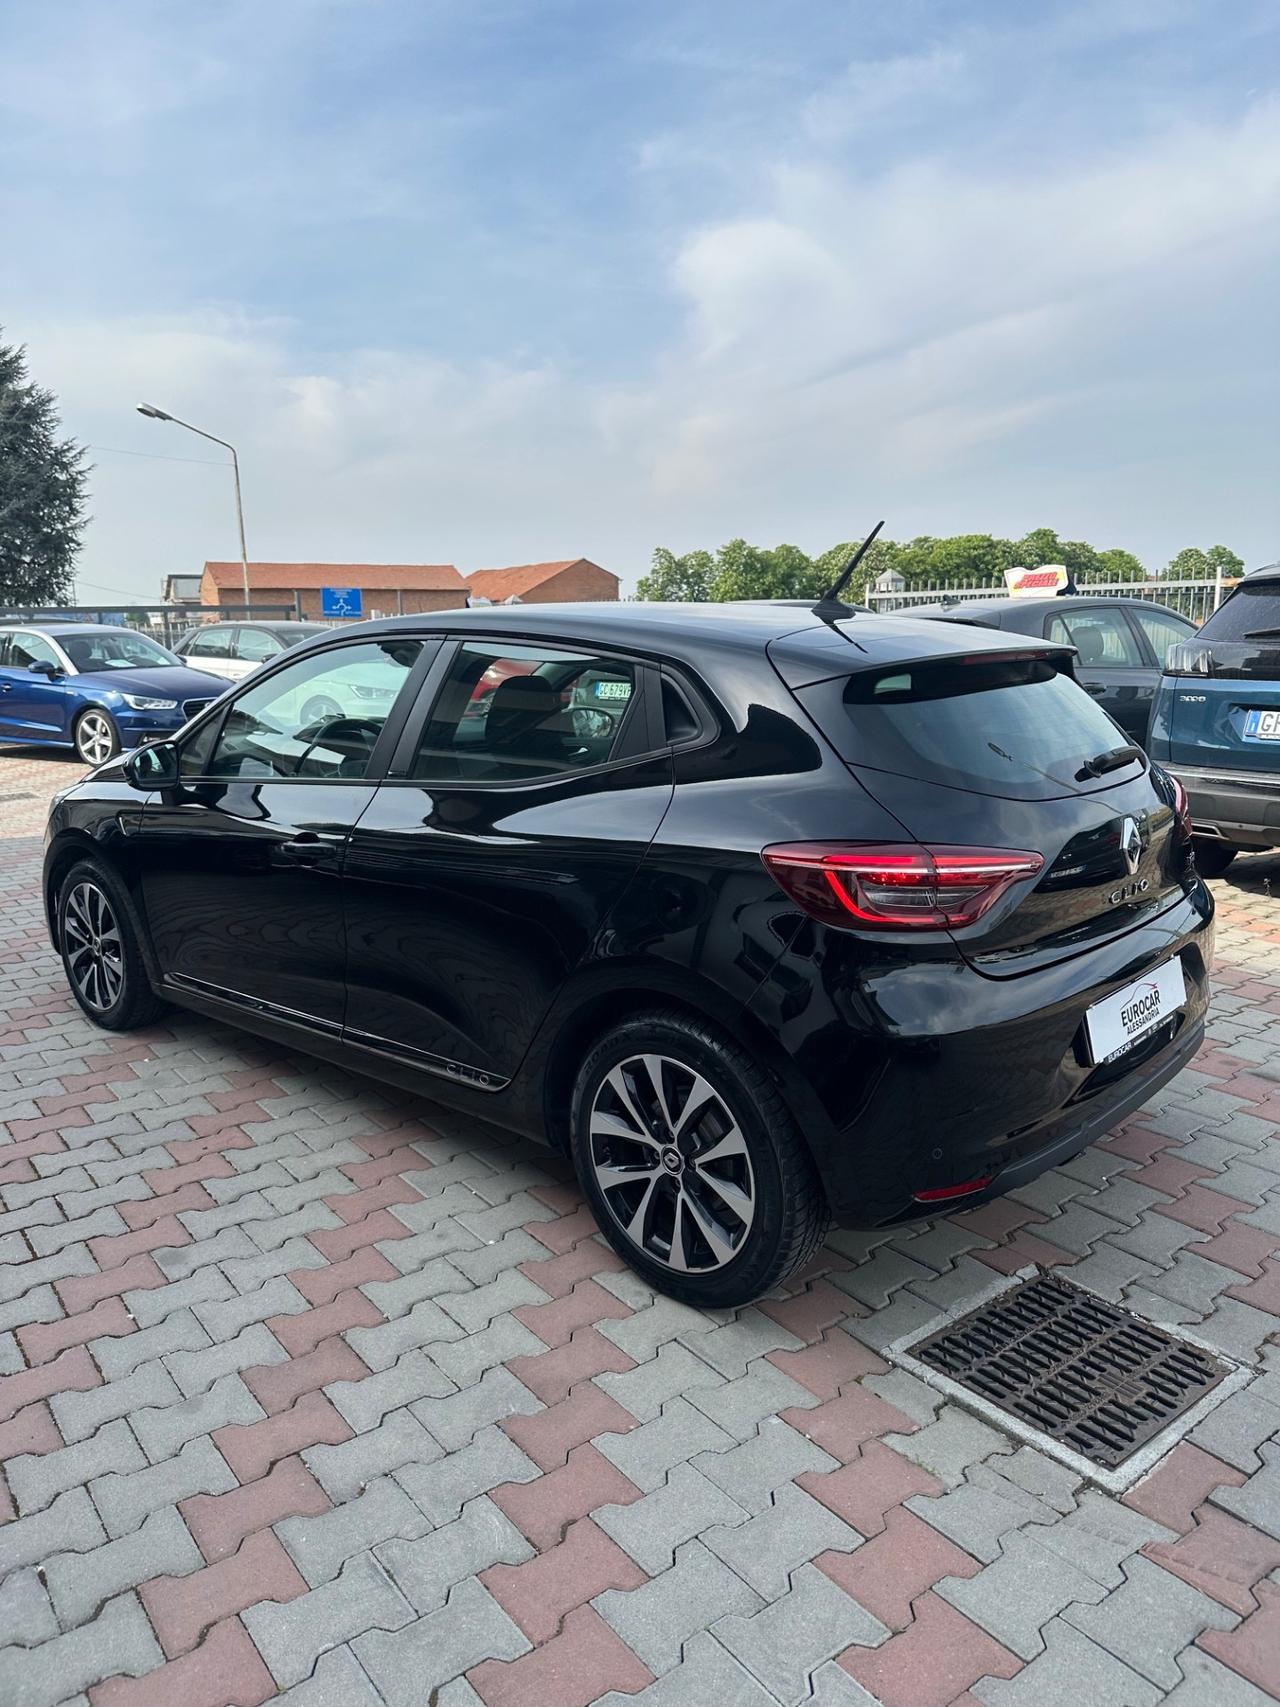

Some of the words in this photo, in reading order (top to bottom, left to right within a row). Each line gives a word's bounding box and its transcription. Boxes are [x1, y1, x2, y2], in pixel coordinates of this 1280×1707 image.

[1110, 878, 1149, 904] CLIO
[1121, 990, 1161, 1027] EUROCAR
[1127, 1007, 1160, 1036] ALESSANDRIA
[1107, 1042, 1132, 1063] EUROCAR
